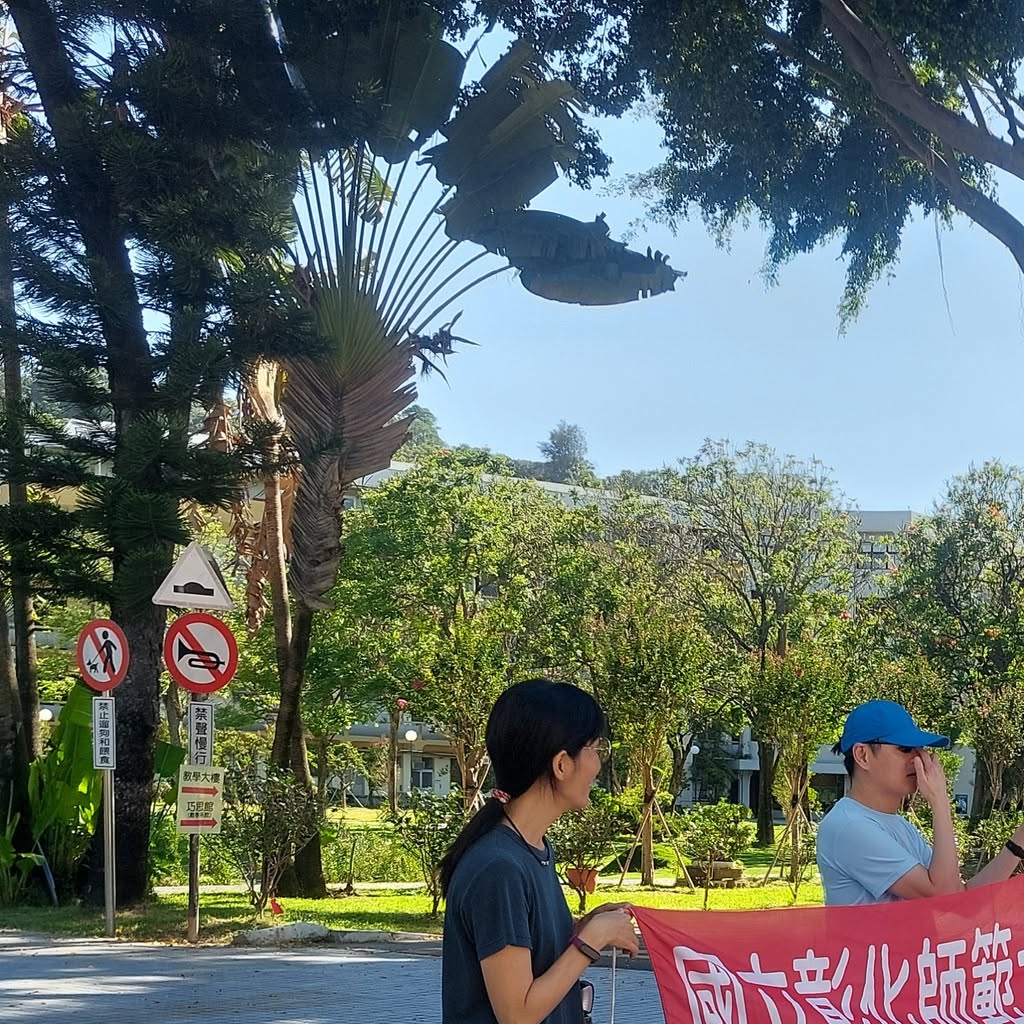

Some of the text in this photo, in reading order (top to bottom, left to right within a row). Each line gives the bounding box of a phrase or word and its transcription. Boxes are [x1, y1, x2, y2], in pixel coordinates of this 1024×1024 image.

[183, 771, 221, 784] 教學大樓
[186, 801, 215, 812] 巧思館
